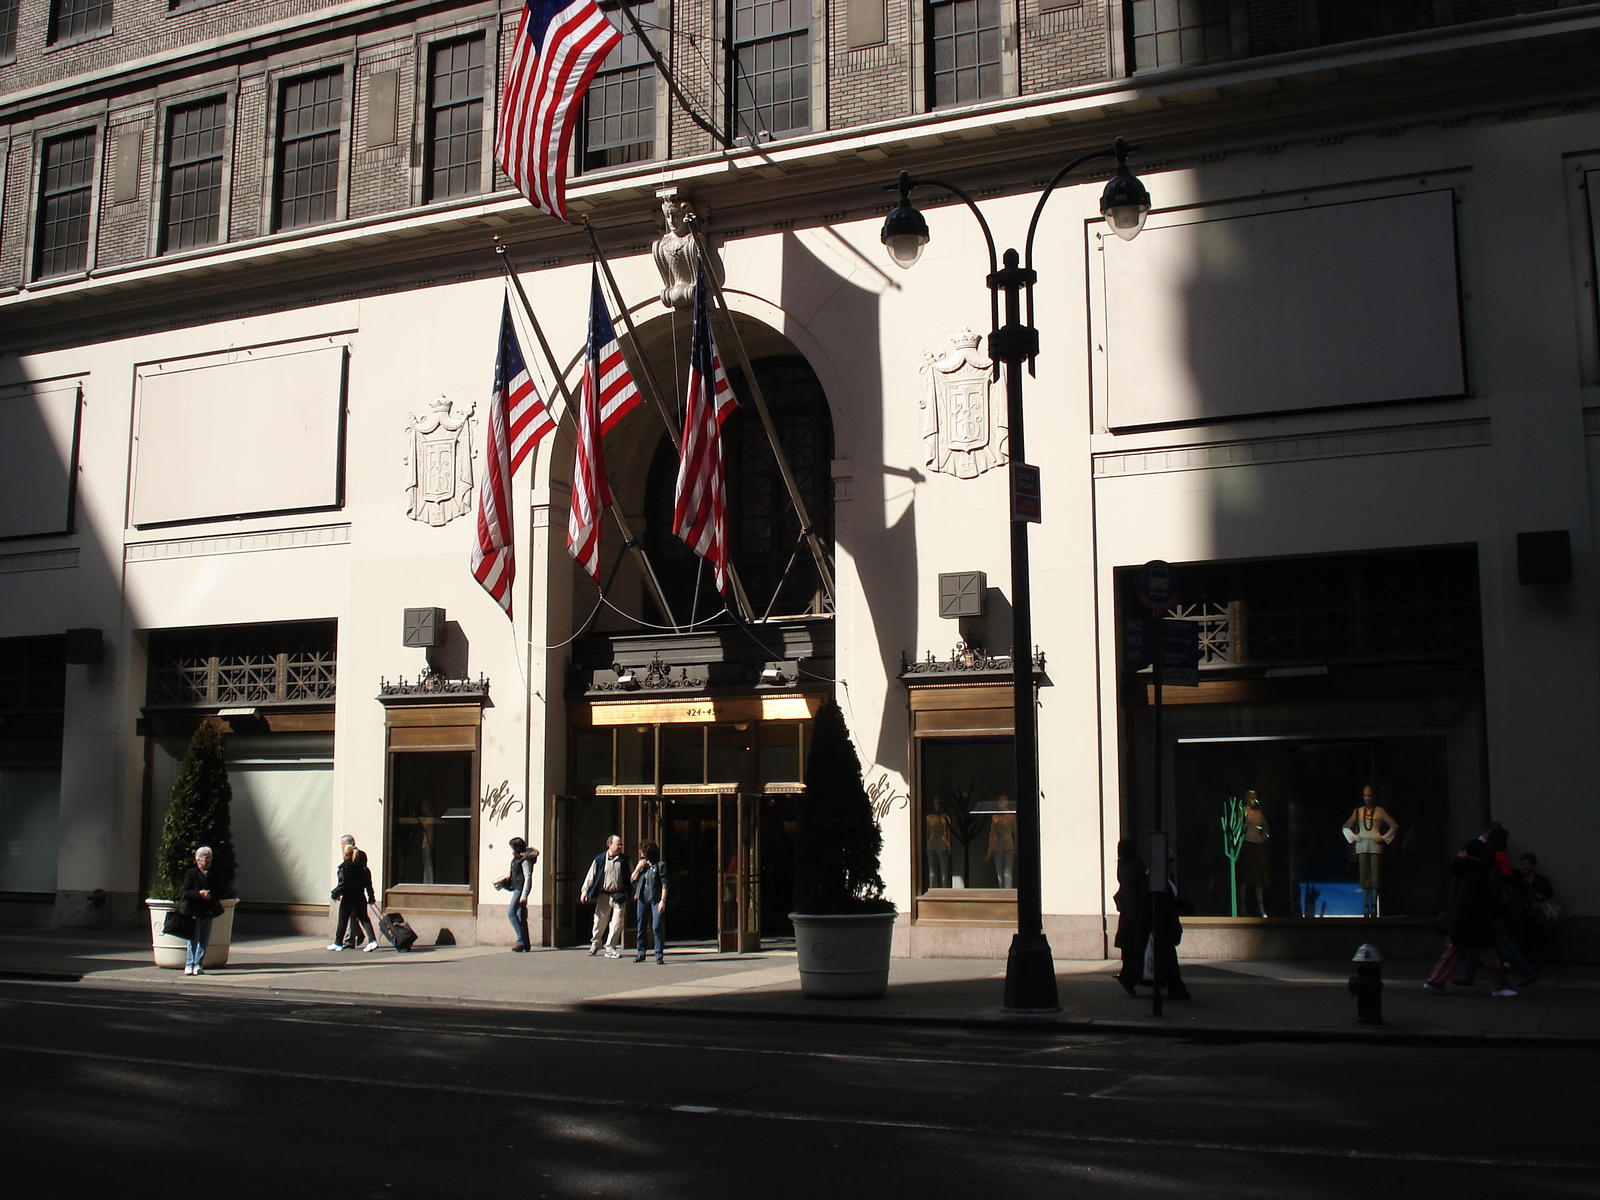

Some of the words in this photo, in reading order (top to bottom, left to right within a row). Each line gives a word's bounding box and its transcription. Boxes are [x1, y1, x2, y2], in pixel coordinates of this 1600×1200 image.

[1128, 619, 1142, 631] M2
[1127, 635, 1142, 646] M3
[1128, 650, 1142, 661] M5
